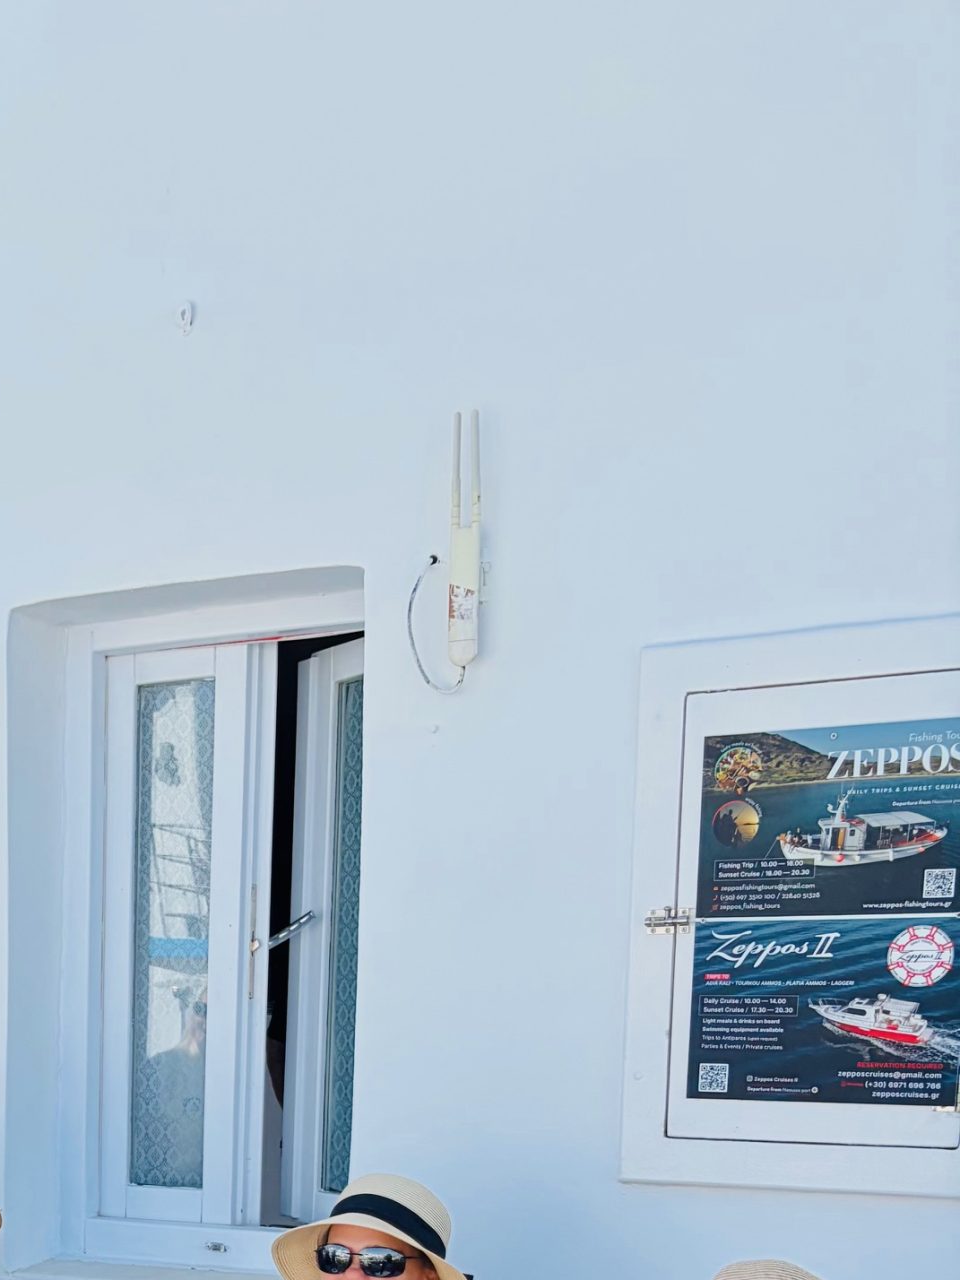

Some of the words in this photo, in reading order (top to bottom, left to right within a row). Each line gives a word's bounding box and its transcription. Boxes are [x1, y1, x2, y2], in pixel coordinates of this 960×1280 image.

[909, 732, 942, 742] Fishing
[826, 742, 960, 780] ZEPPOS
[721, 882, 815, 892] zepposfishingtours@gmail.com
[863, 900, 952, 909] www.zeppos-fishingtours.gr
[706, 930, 810, 968] Zeppos
[806, 932, 840, 957] II
[838, 1071, 942, 1079] zepposcruises@gmail.com
[872, 1091, 939, 1100] zepposcruises.gr
